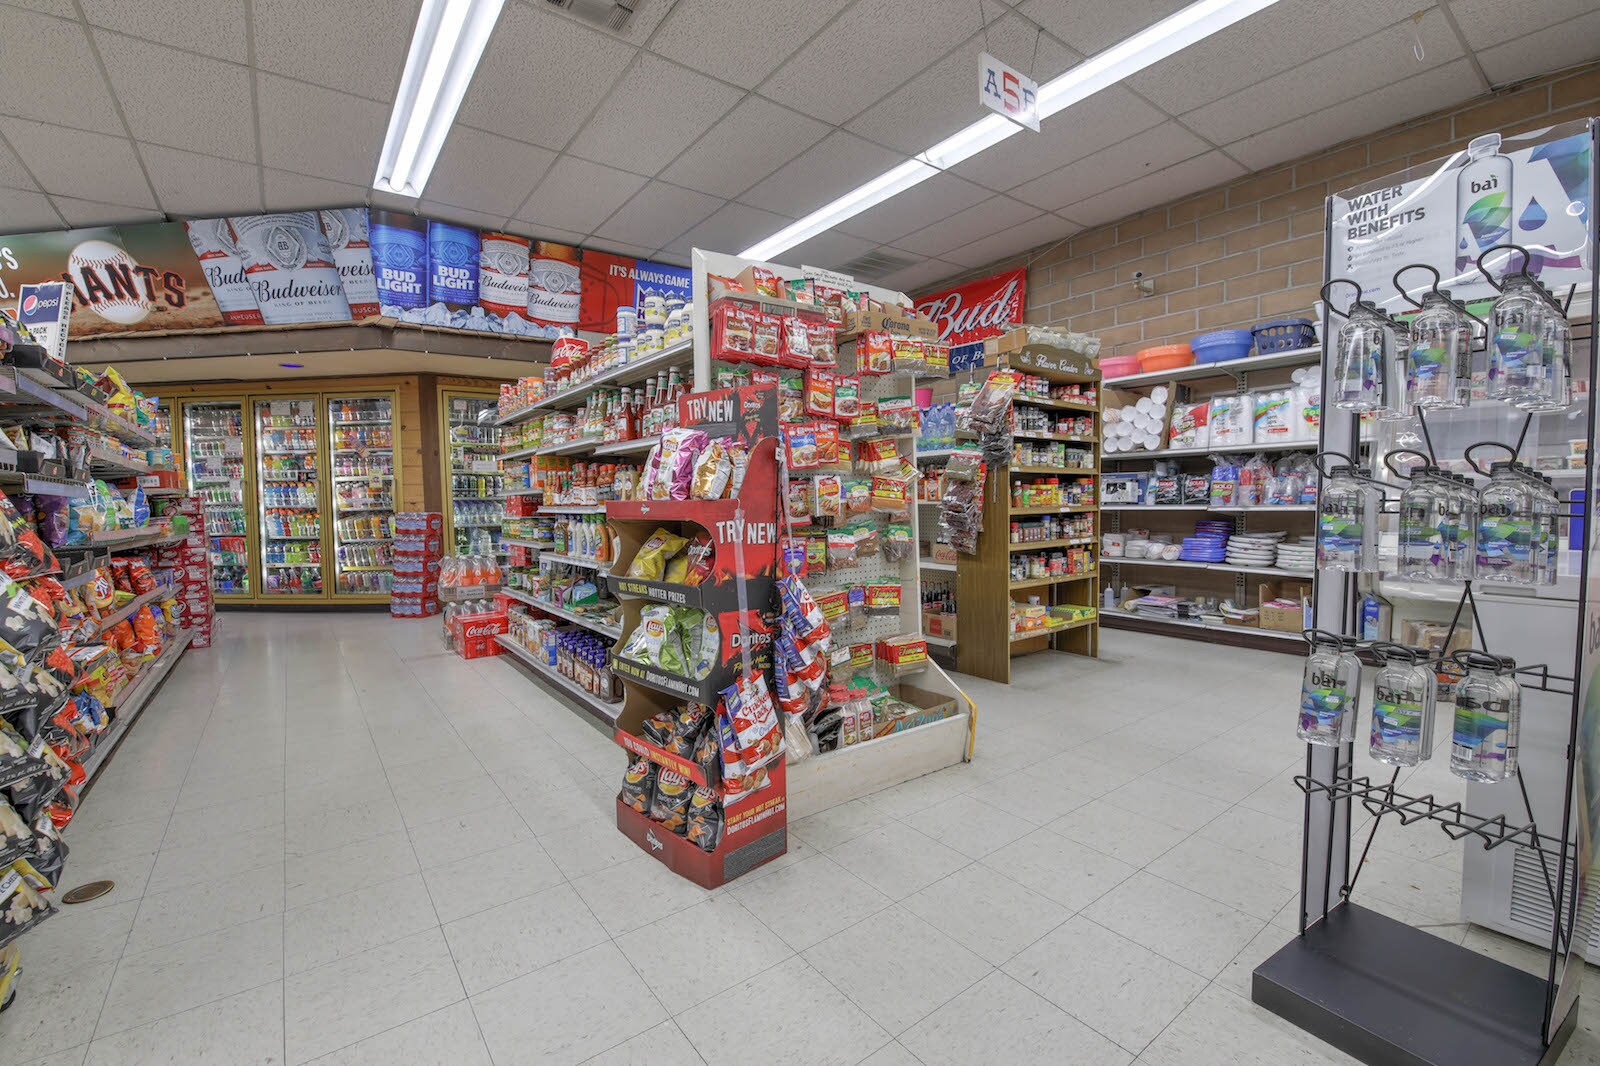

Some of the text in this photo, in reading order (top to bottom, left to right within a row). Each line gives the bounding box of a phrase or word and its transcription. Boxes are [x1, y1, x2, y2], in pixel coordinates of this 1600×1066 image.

[1471, 175, 1499, 194] bai
[1347, 185, 1403, 212] WATER
[1347, 203, 1389, 226] WITH
[1347, 207, 1426, 240] BENEFITS
[382, 267, 417, 283] BUD
[438, 265, 471, 280] BUD
[609, 264, 690, 289] IT'S ALWAYS GAME
[252, 279, 342, 302] Budweiser
[376, 277, 422, 294] LIGHT
[432, 274, 475, 290] LIGHT
[38, 296, 59, 310] pepsi
[352, 306, 378, 314] BUSCH
[529, 293, 579, 309] Budweiser
[916, 279, 1019, 342] Bud
[881, 317, 910, 331] Corona
[951, 354, 969, 365] OF
[1058, 359, 1079, 374] Center
[686, 396, 734, 422] TRY NEW
[716, 518, 777, 545] TRY NEW
[648, 586, 668, 600] HOTTER
[668, 591, 687, 604] PRIZES
[741, 690, 771, 717] Cracker
[752, 704, 770, 725] Jack
[726, 812, 743, 826] START
